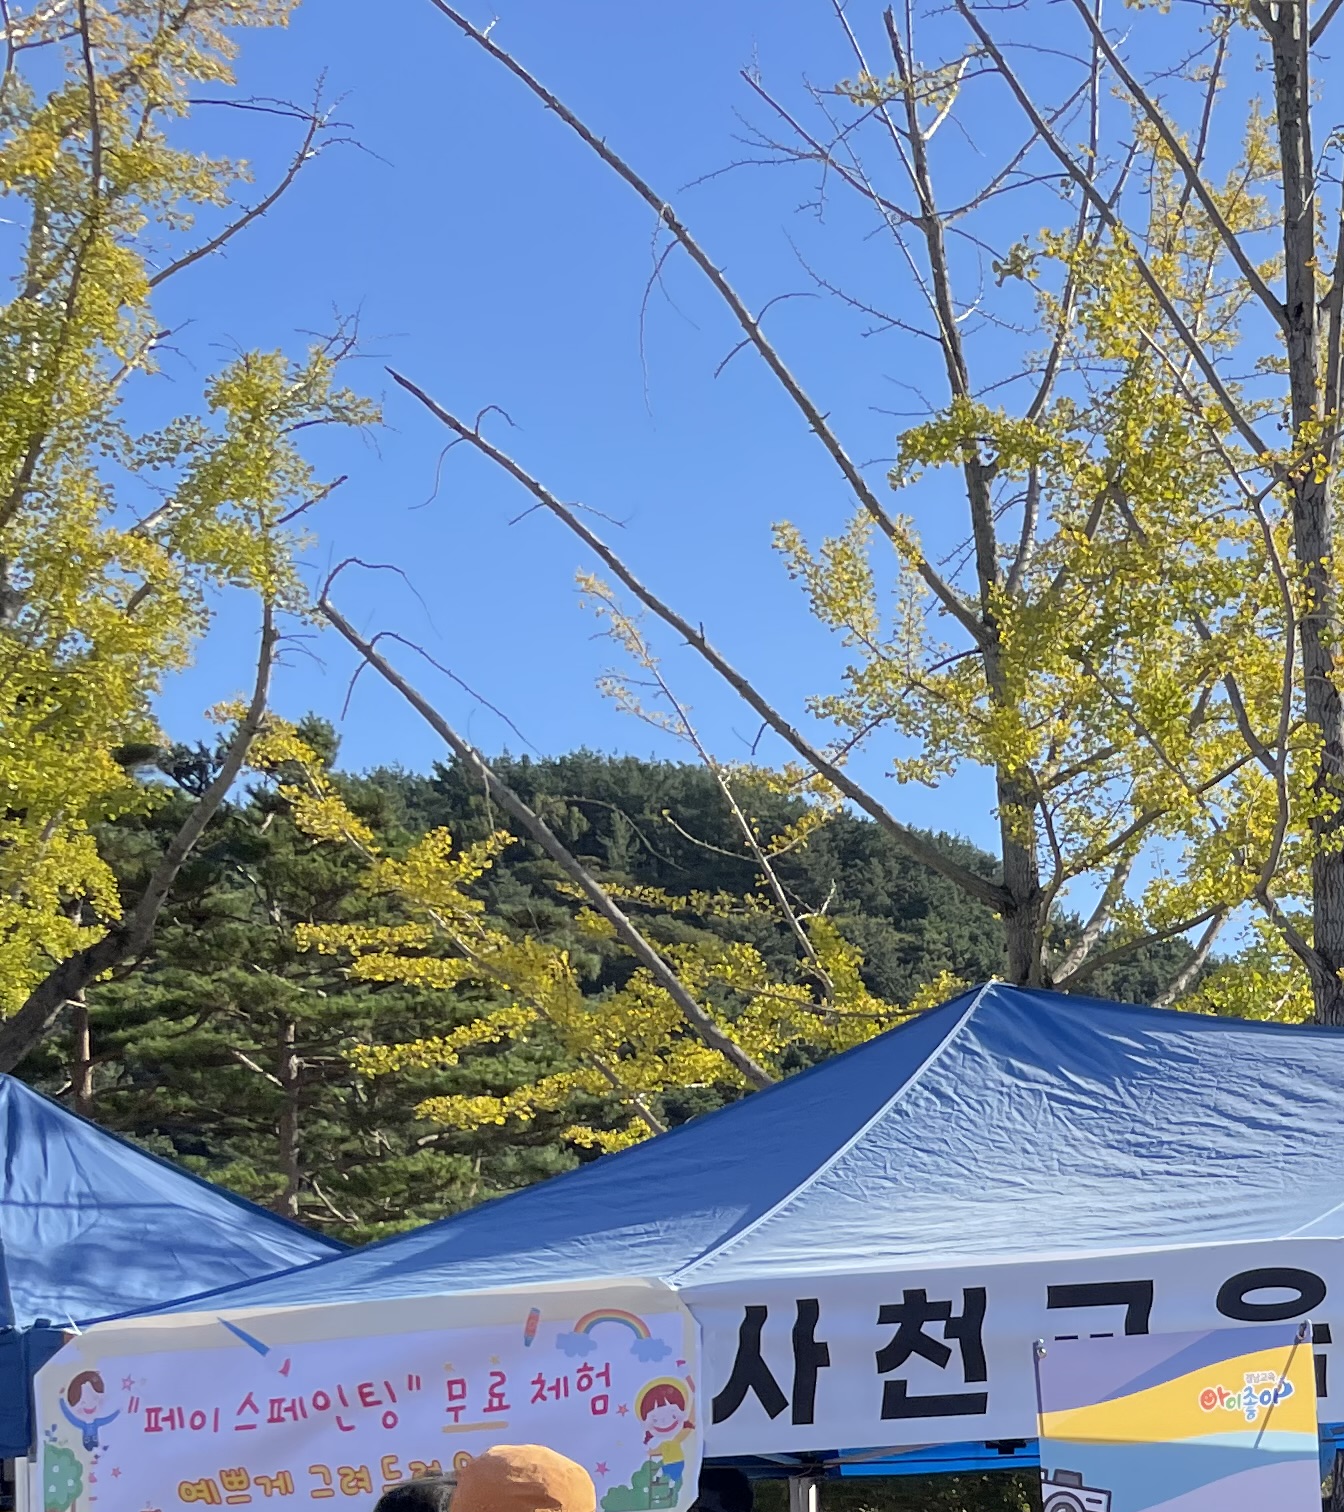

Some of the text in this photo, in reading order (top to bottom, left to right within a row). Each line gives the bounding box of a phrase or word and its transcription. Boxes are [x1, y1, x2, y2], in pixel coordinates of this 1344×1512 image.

[446, 1371, 511, 1423] 무료
[531, 1362, 611, 1416] 체험
[309, 1464, 373, 1498] 그려
